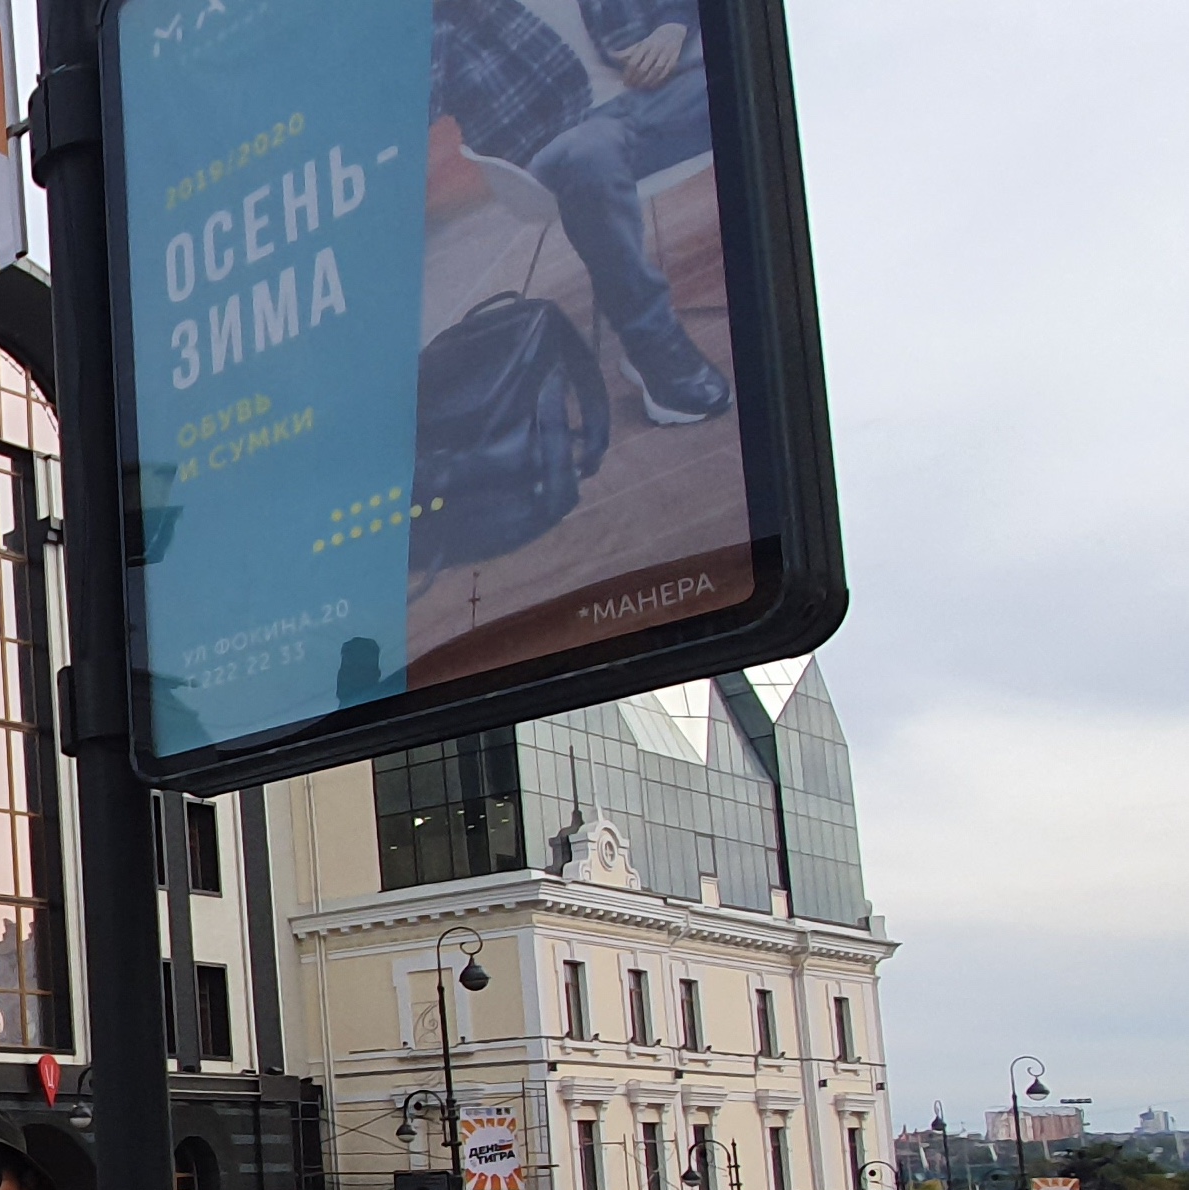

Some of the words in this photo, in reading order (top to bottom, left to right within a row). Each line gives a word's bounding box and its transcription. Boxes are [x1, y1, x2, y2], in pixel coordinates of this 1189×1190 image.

[171, 246, 346, 389] ЗИМА
[178, 393, 271, 448] ОБУВЬ
[209, 405, 314, 469] СУМКИ
[469, 1143, 503, 1158] ДЕНЬ
[477, 1150, 516, 1164] ТИГРА
